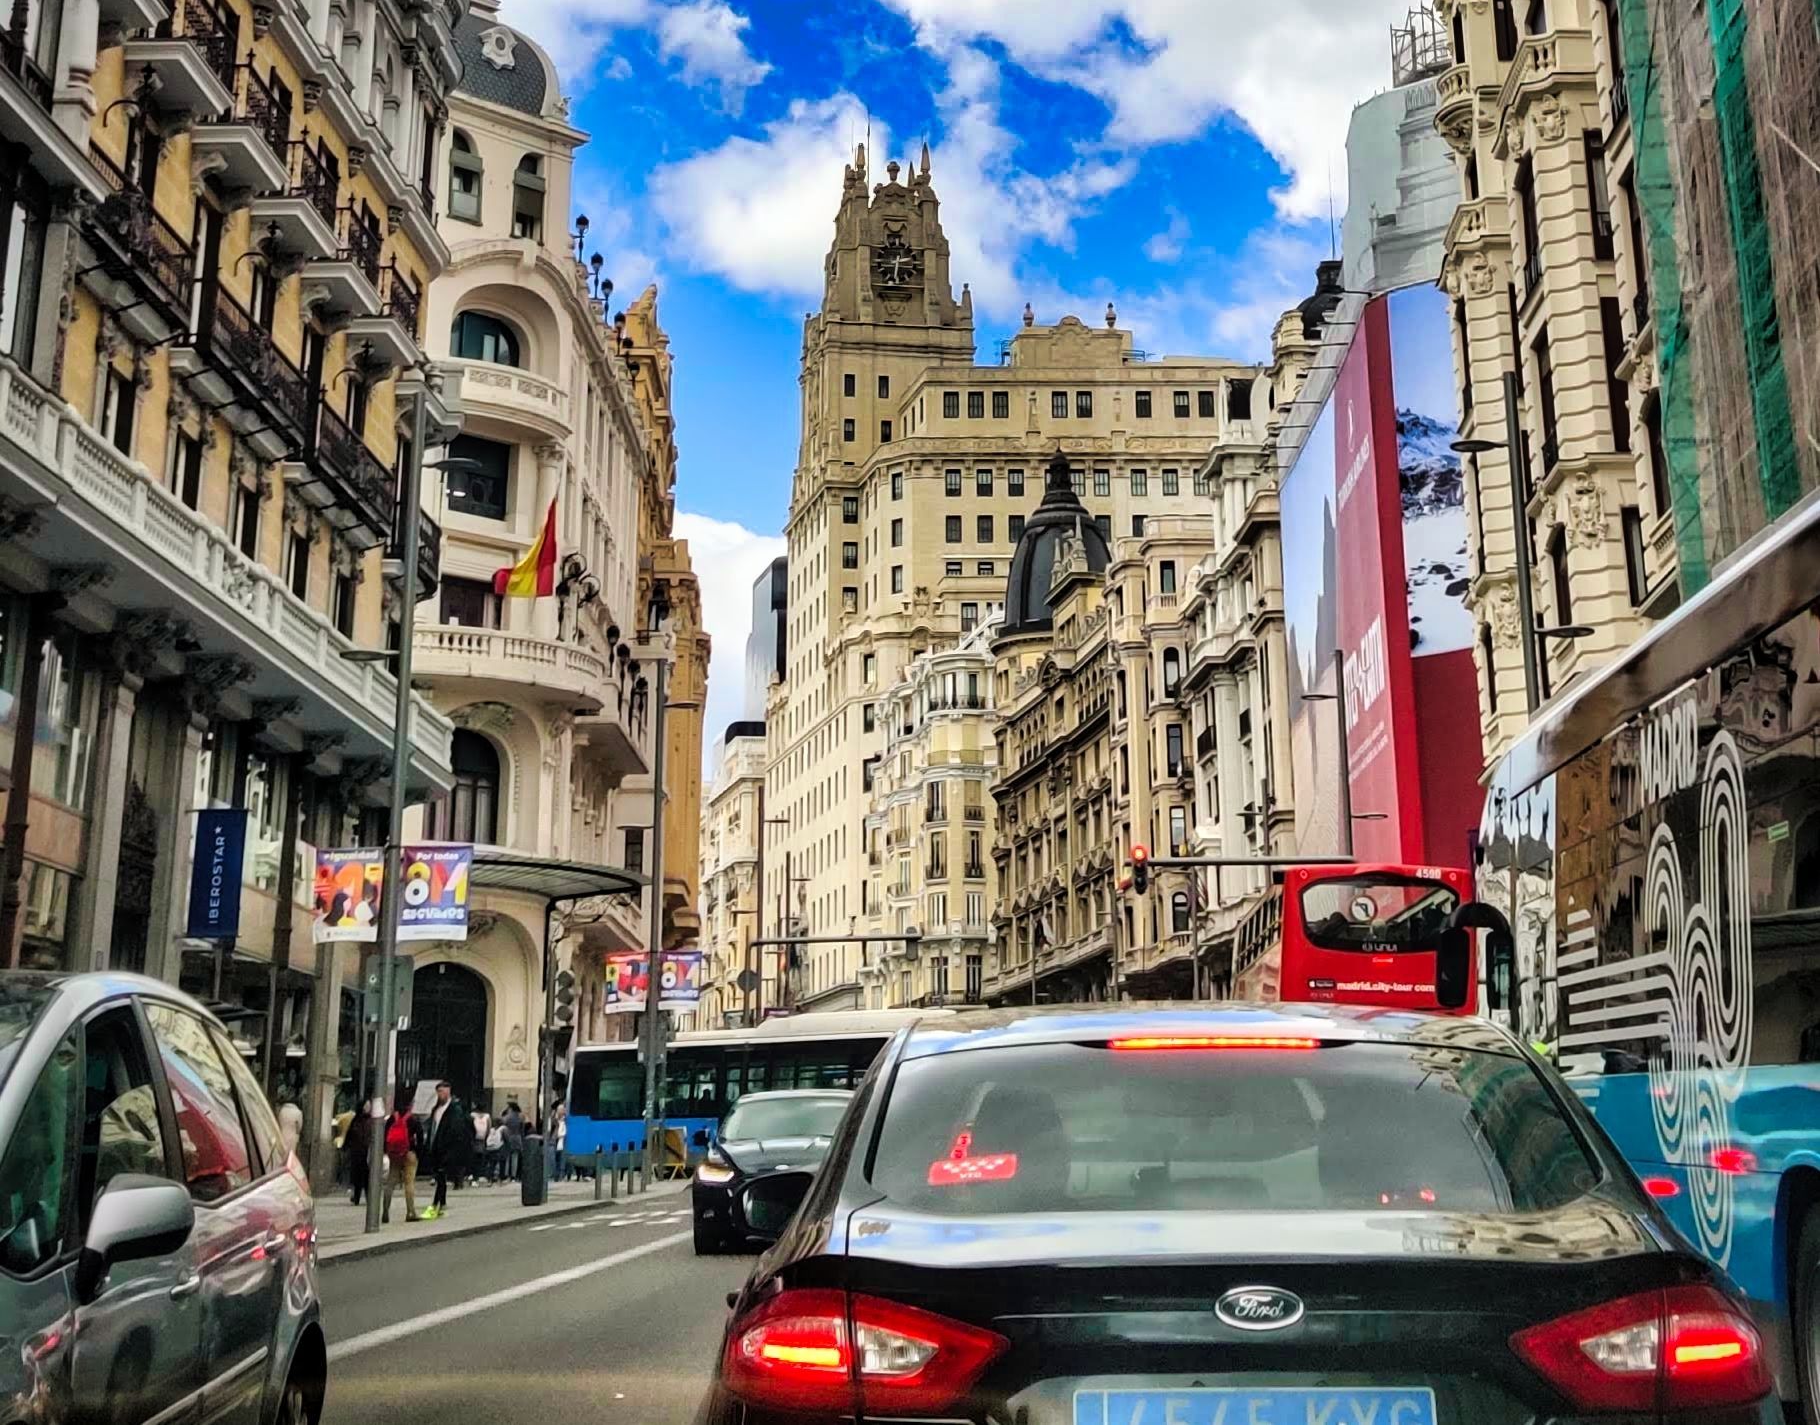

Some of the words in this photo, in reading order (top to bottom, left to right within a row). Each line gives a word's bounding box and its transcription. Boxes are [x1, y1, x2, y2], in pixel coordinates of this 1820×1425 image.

[1640, 698, 1698, 808] MADRID
[208, 836, 226, 924] IBEROSTAR
[1235, 1295, 1284, 1318] Ford
